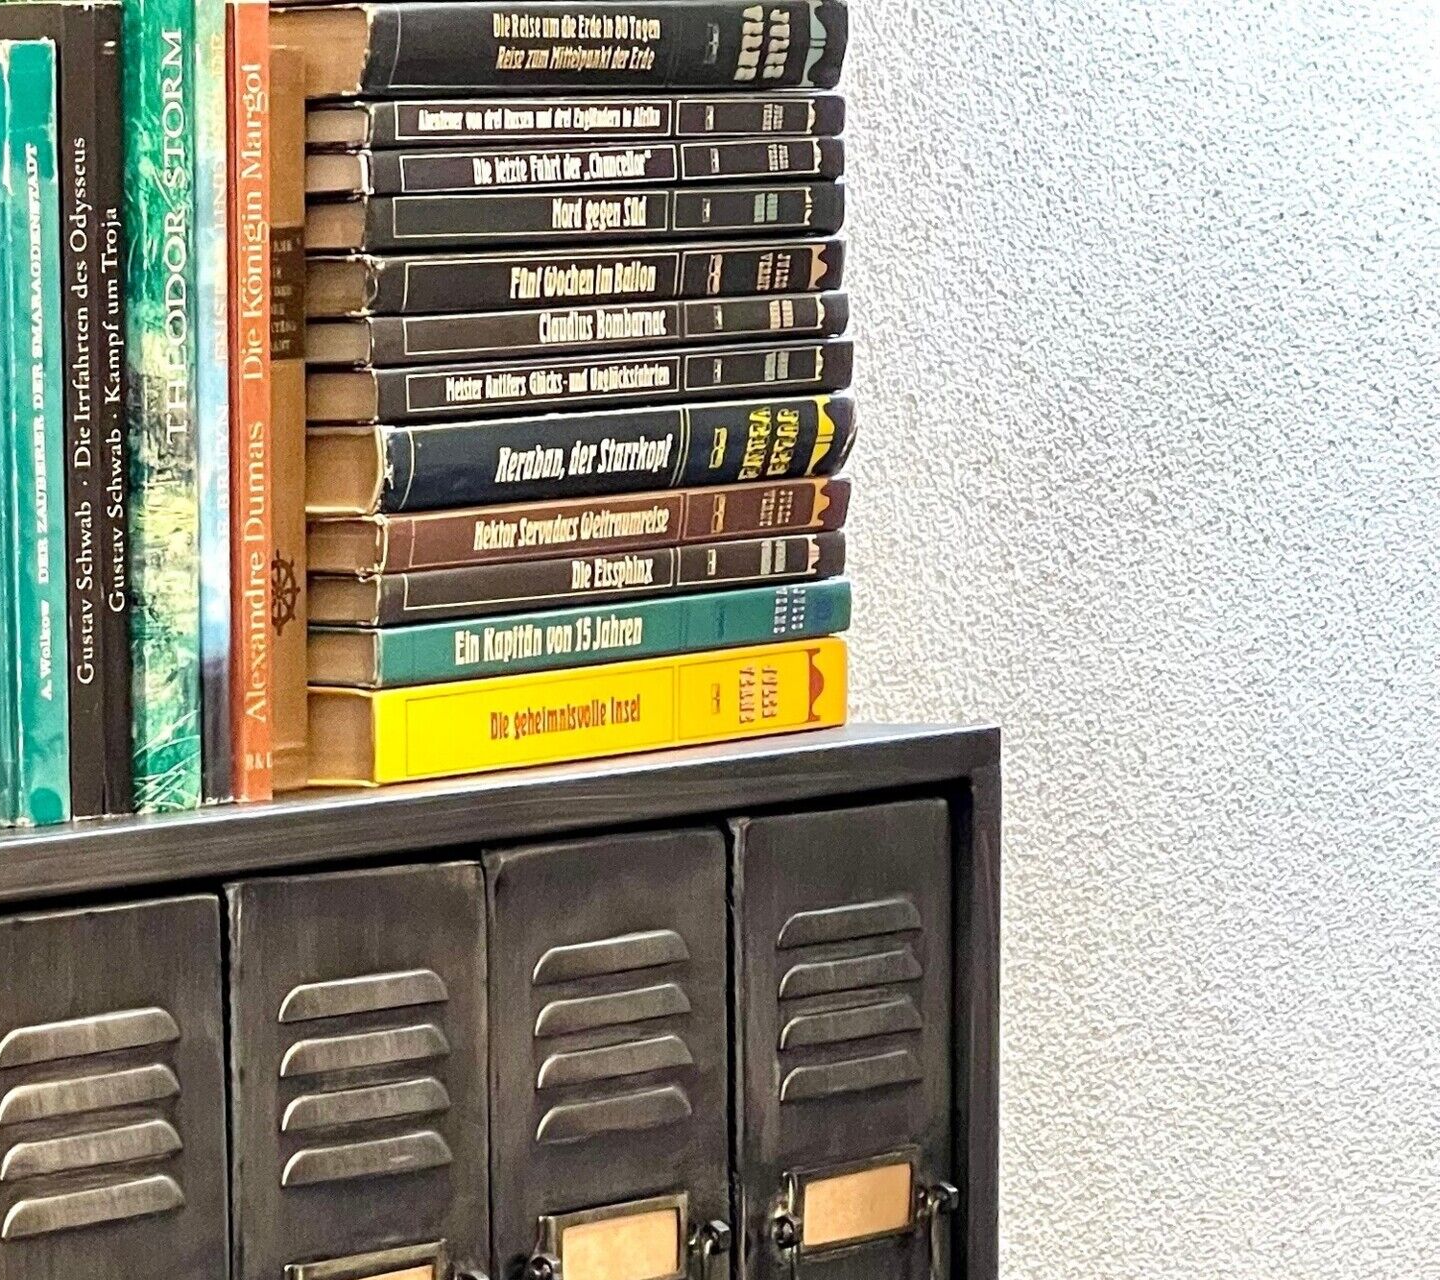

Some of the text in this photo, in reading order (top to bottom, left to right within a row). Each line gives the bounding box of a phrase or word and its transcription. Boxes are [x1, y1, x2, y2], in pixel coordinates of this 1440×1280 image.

[493, 13, 661, 42] Die Reise um die Erde in 80 Tagen
[495, 45, 655, 71] Reise zum Mittelpunkt der Erde
[240, 63, 269, 182] Margot
[473, 158, 492, 185] Die
[494, 156, 527, 183] letzte
[530, 154, 561, 181] Fahrt
[563, 153, 581, 179] der
[160, 28, 188, 445] THEODOR STORM
[585, 200, 621, 231] gegen
[623, 196, 647, 227] Süd
[241, 191, 268, 318] Königin
[510, 261, 656, 299] Fünf Wochen im Ballon
[539, 307, 667, 343] Claudius Bombarnac
[241, 329, 263, 379] Die
[31, 362, 44, 410] DER
[100, 207, 126, 613] Gustav Schwab Kampf um Troja
[69, 137, 94, 685] Gustav Schwab Die Irrfahrten des Odysseus
[568, 440, 597, 475] der
[596, 433, 673, 473] Starrkopf
[244, 421, 266, 543] Dumas
[472, 505, 670, 551] Hektor Servadacs Weltraumreise
[572, 555, 654, 589] Die Eissphinx
[40, 600, 52, 678] Wolkow
[244, 552, 267, 724] Alexandre
[455, 614, 643, 665] Ein Kapitän von 15 Jahren
[490, 694, 641, 740] Die geheimnisvolle Insel
